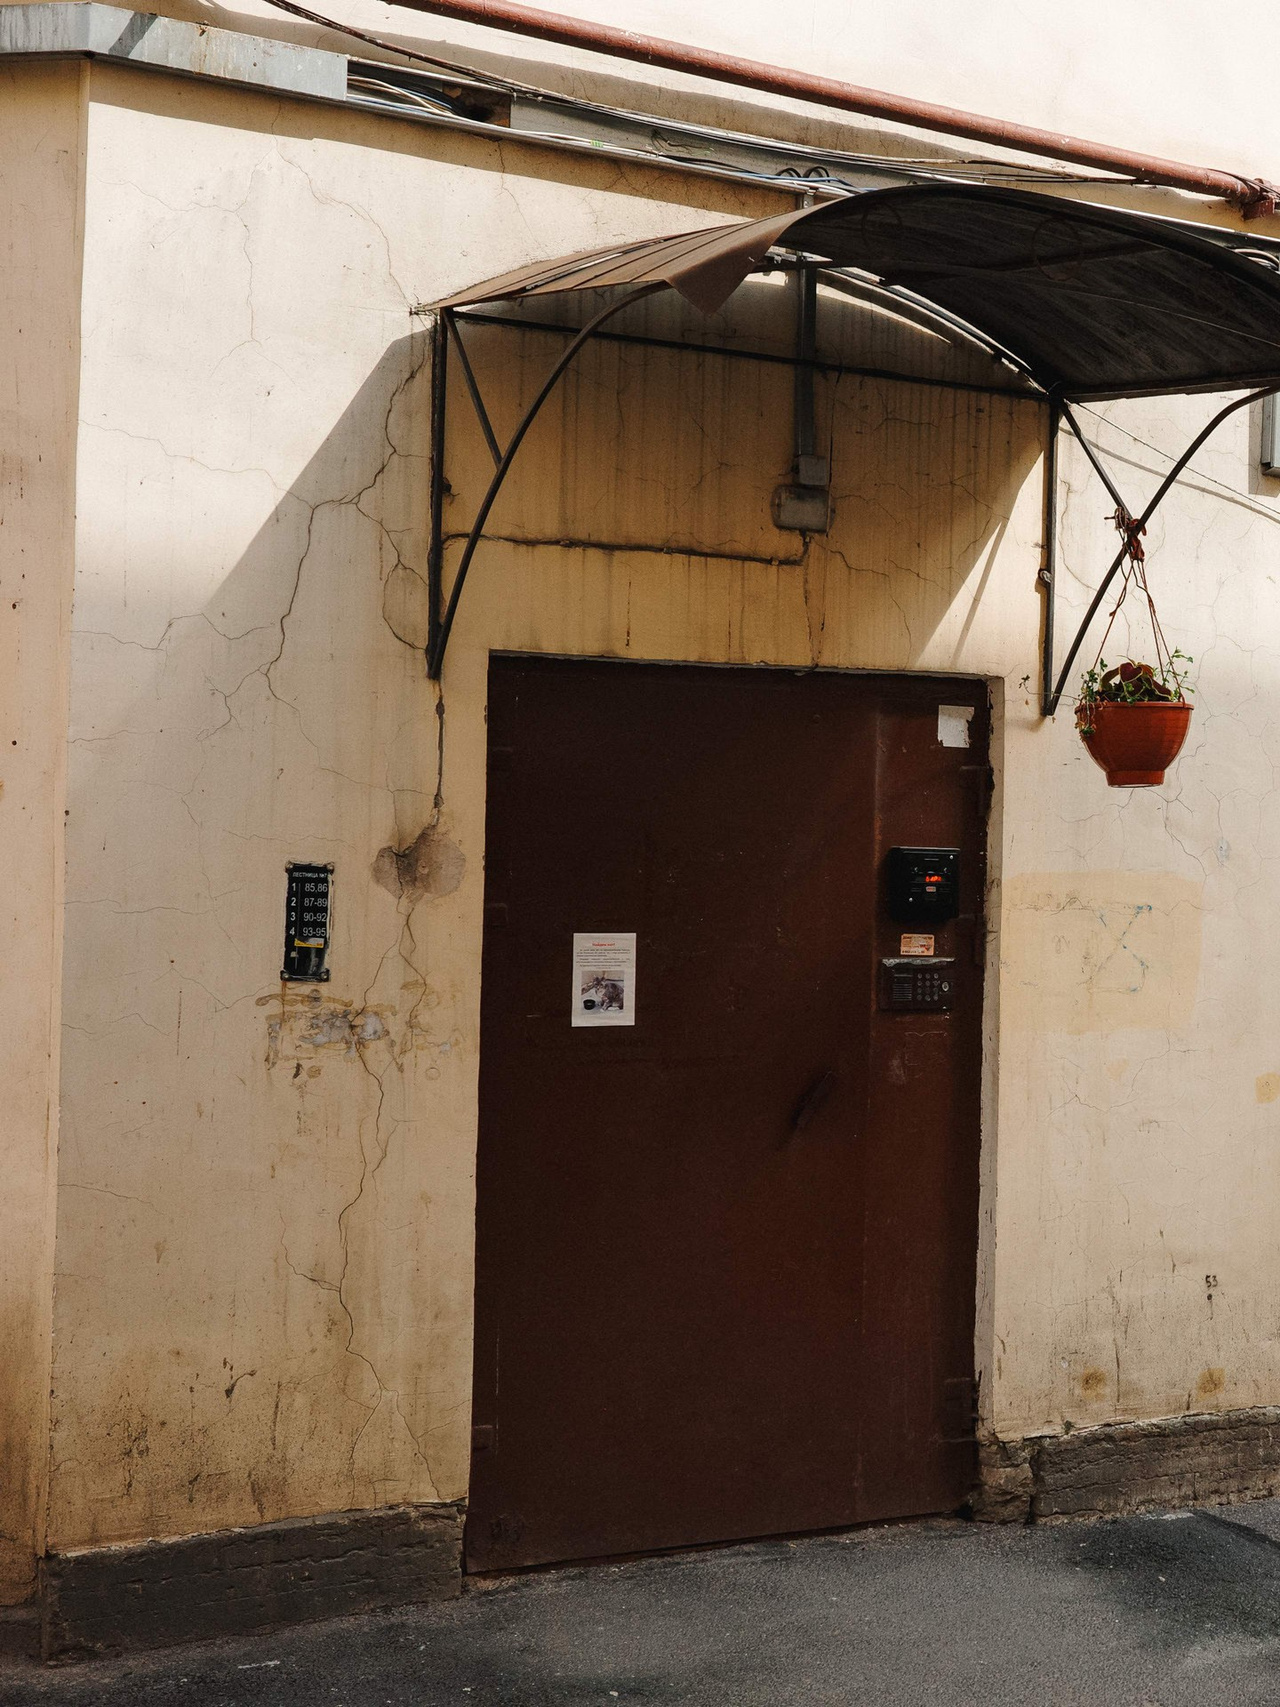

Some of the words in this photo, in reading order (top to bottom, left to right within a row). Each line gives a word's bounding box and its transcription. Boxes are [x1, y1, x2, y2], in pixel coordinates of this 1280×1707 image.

[291, 883, 296, 891] 1
[304, 883, 328, 893] 85,86
[290, 897, 296, 906] 2
[303, 897, 328, 907] 87-89
[290, 912, 296, 921] 3
[303, 912, 327, 922] 90-92
[289, 927, 295, 936] 4
[302, 927, 326, 937] 93-95
